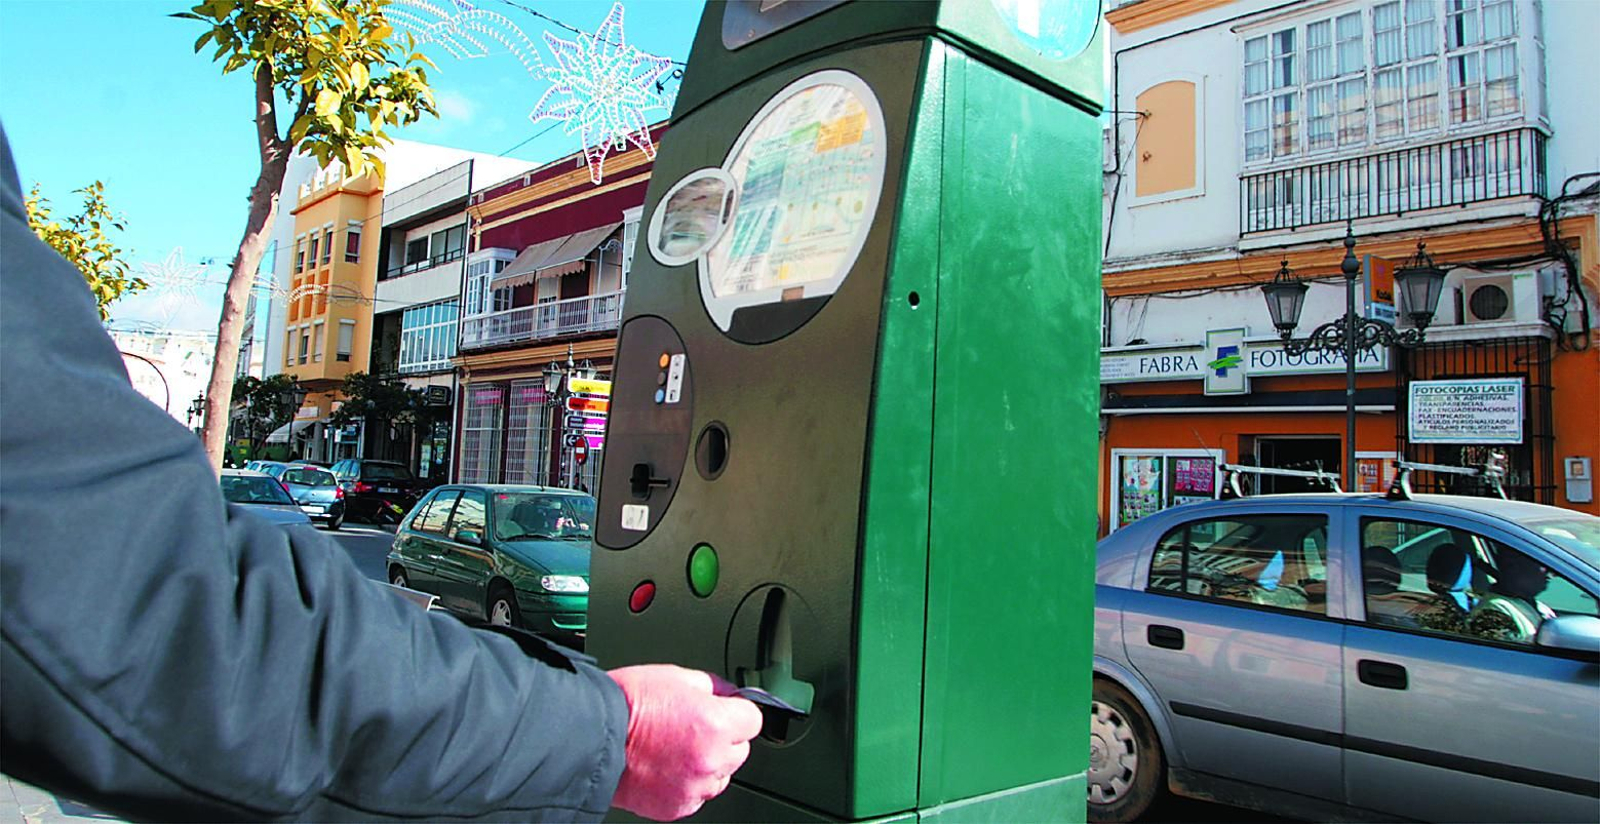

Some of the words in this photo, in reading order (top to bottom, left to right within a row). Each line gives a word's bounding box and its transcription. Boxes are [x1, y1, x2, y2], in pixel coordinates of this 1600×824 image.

[1140, 355, 1198, 373] FABRA
[1251, 347, 1379, 368] FOTOGRAIA
[1415, 386, 1479, 394] FOTOCOPIAS
[1482, 385, 1515, 393] LASER
